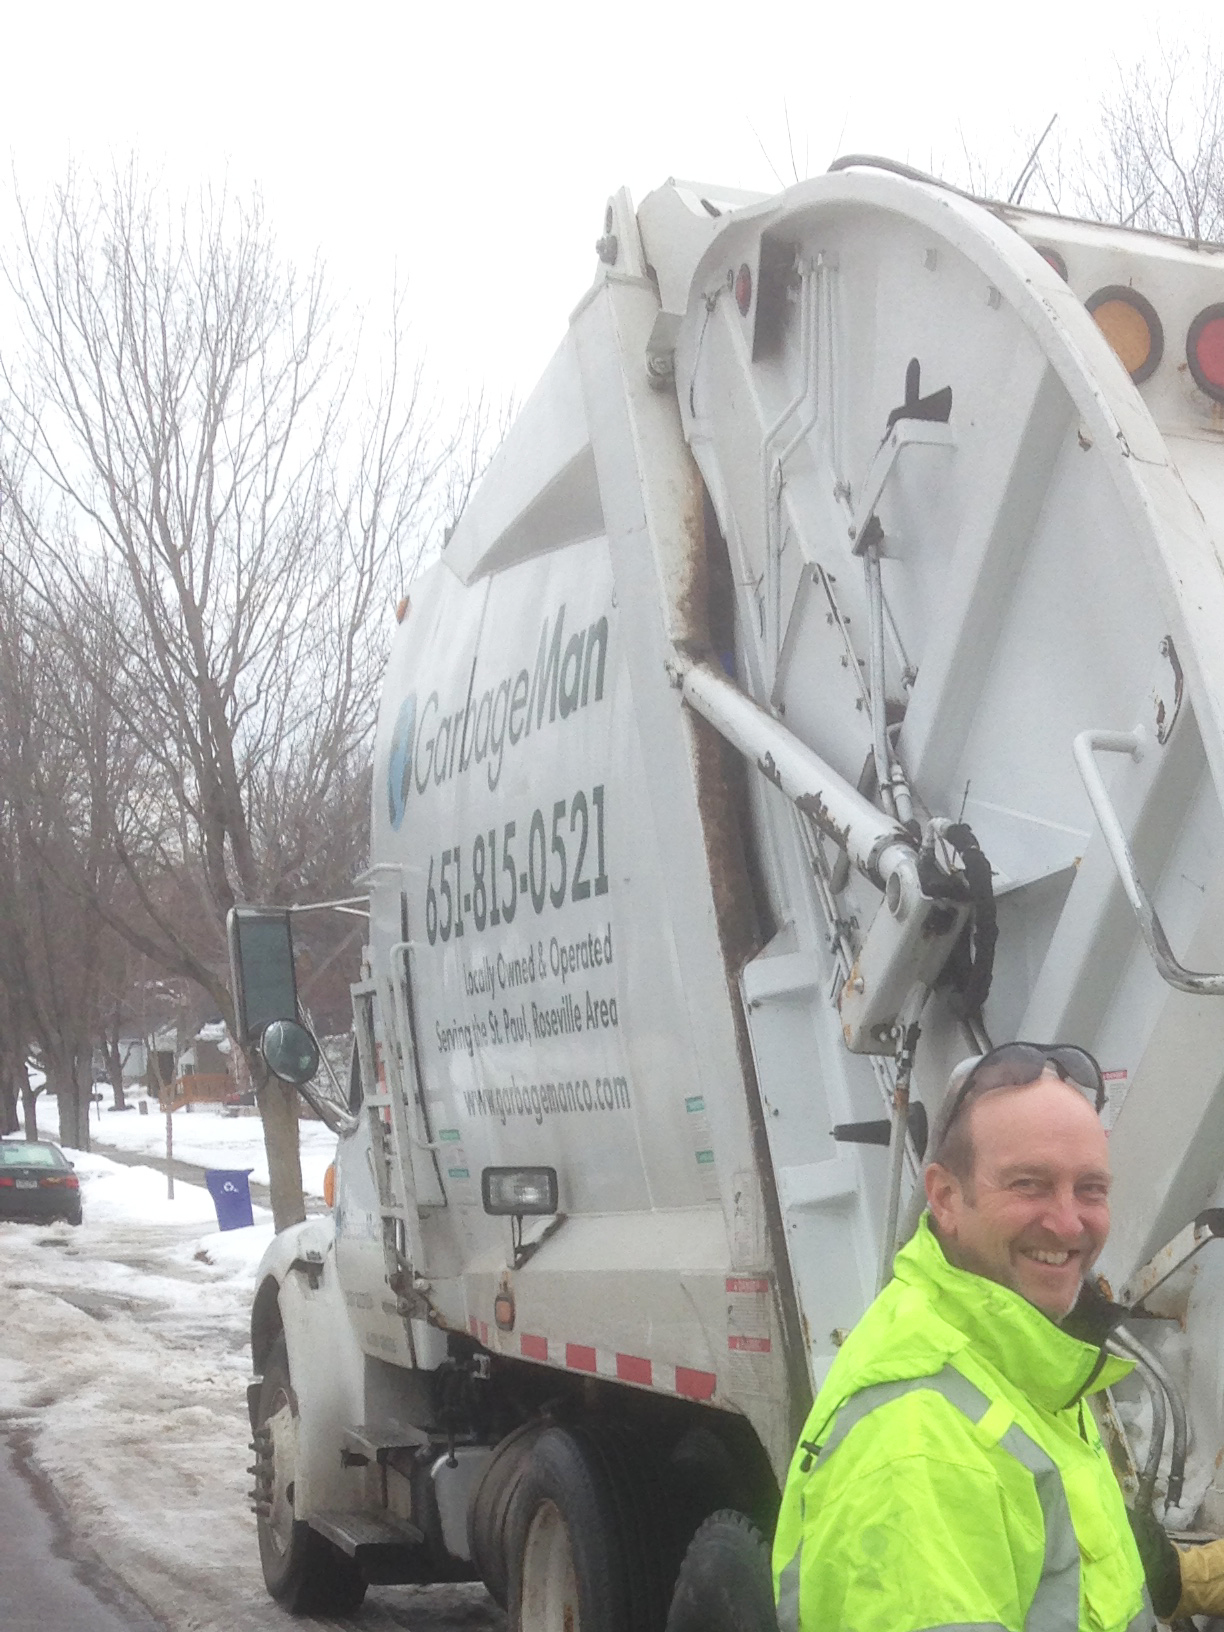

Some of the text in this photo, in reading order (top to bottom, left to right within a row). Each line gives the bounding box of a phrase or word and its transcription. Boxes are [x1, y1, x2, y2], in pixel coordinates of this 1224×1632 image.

[415, 603, 609, 795] GarbageMan
[426, 784, 609, 946] 651-815-0521
[462, 921, 614, 1000] Locally Owned & Operated
[435, 1018, 475, 1058] Serving
[473, 1014, 488, 1048] the
[502, 1003, 533, 1048] Paul,
[531, 993, 582, 1040] Roseville
[585, 990, 619, 1030] Area
[463, 1074, 631, 1126] www.garbagemanco.com
